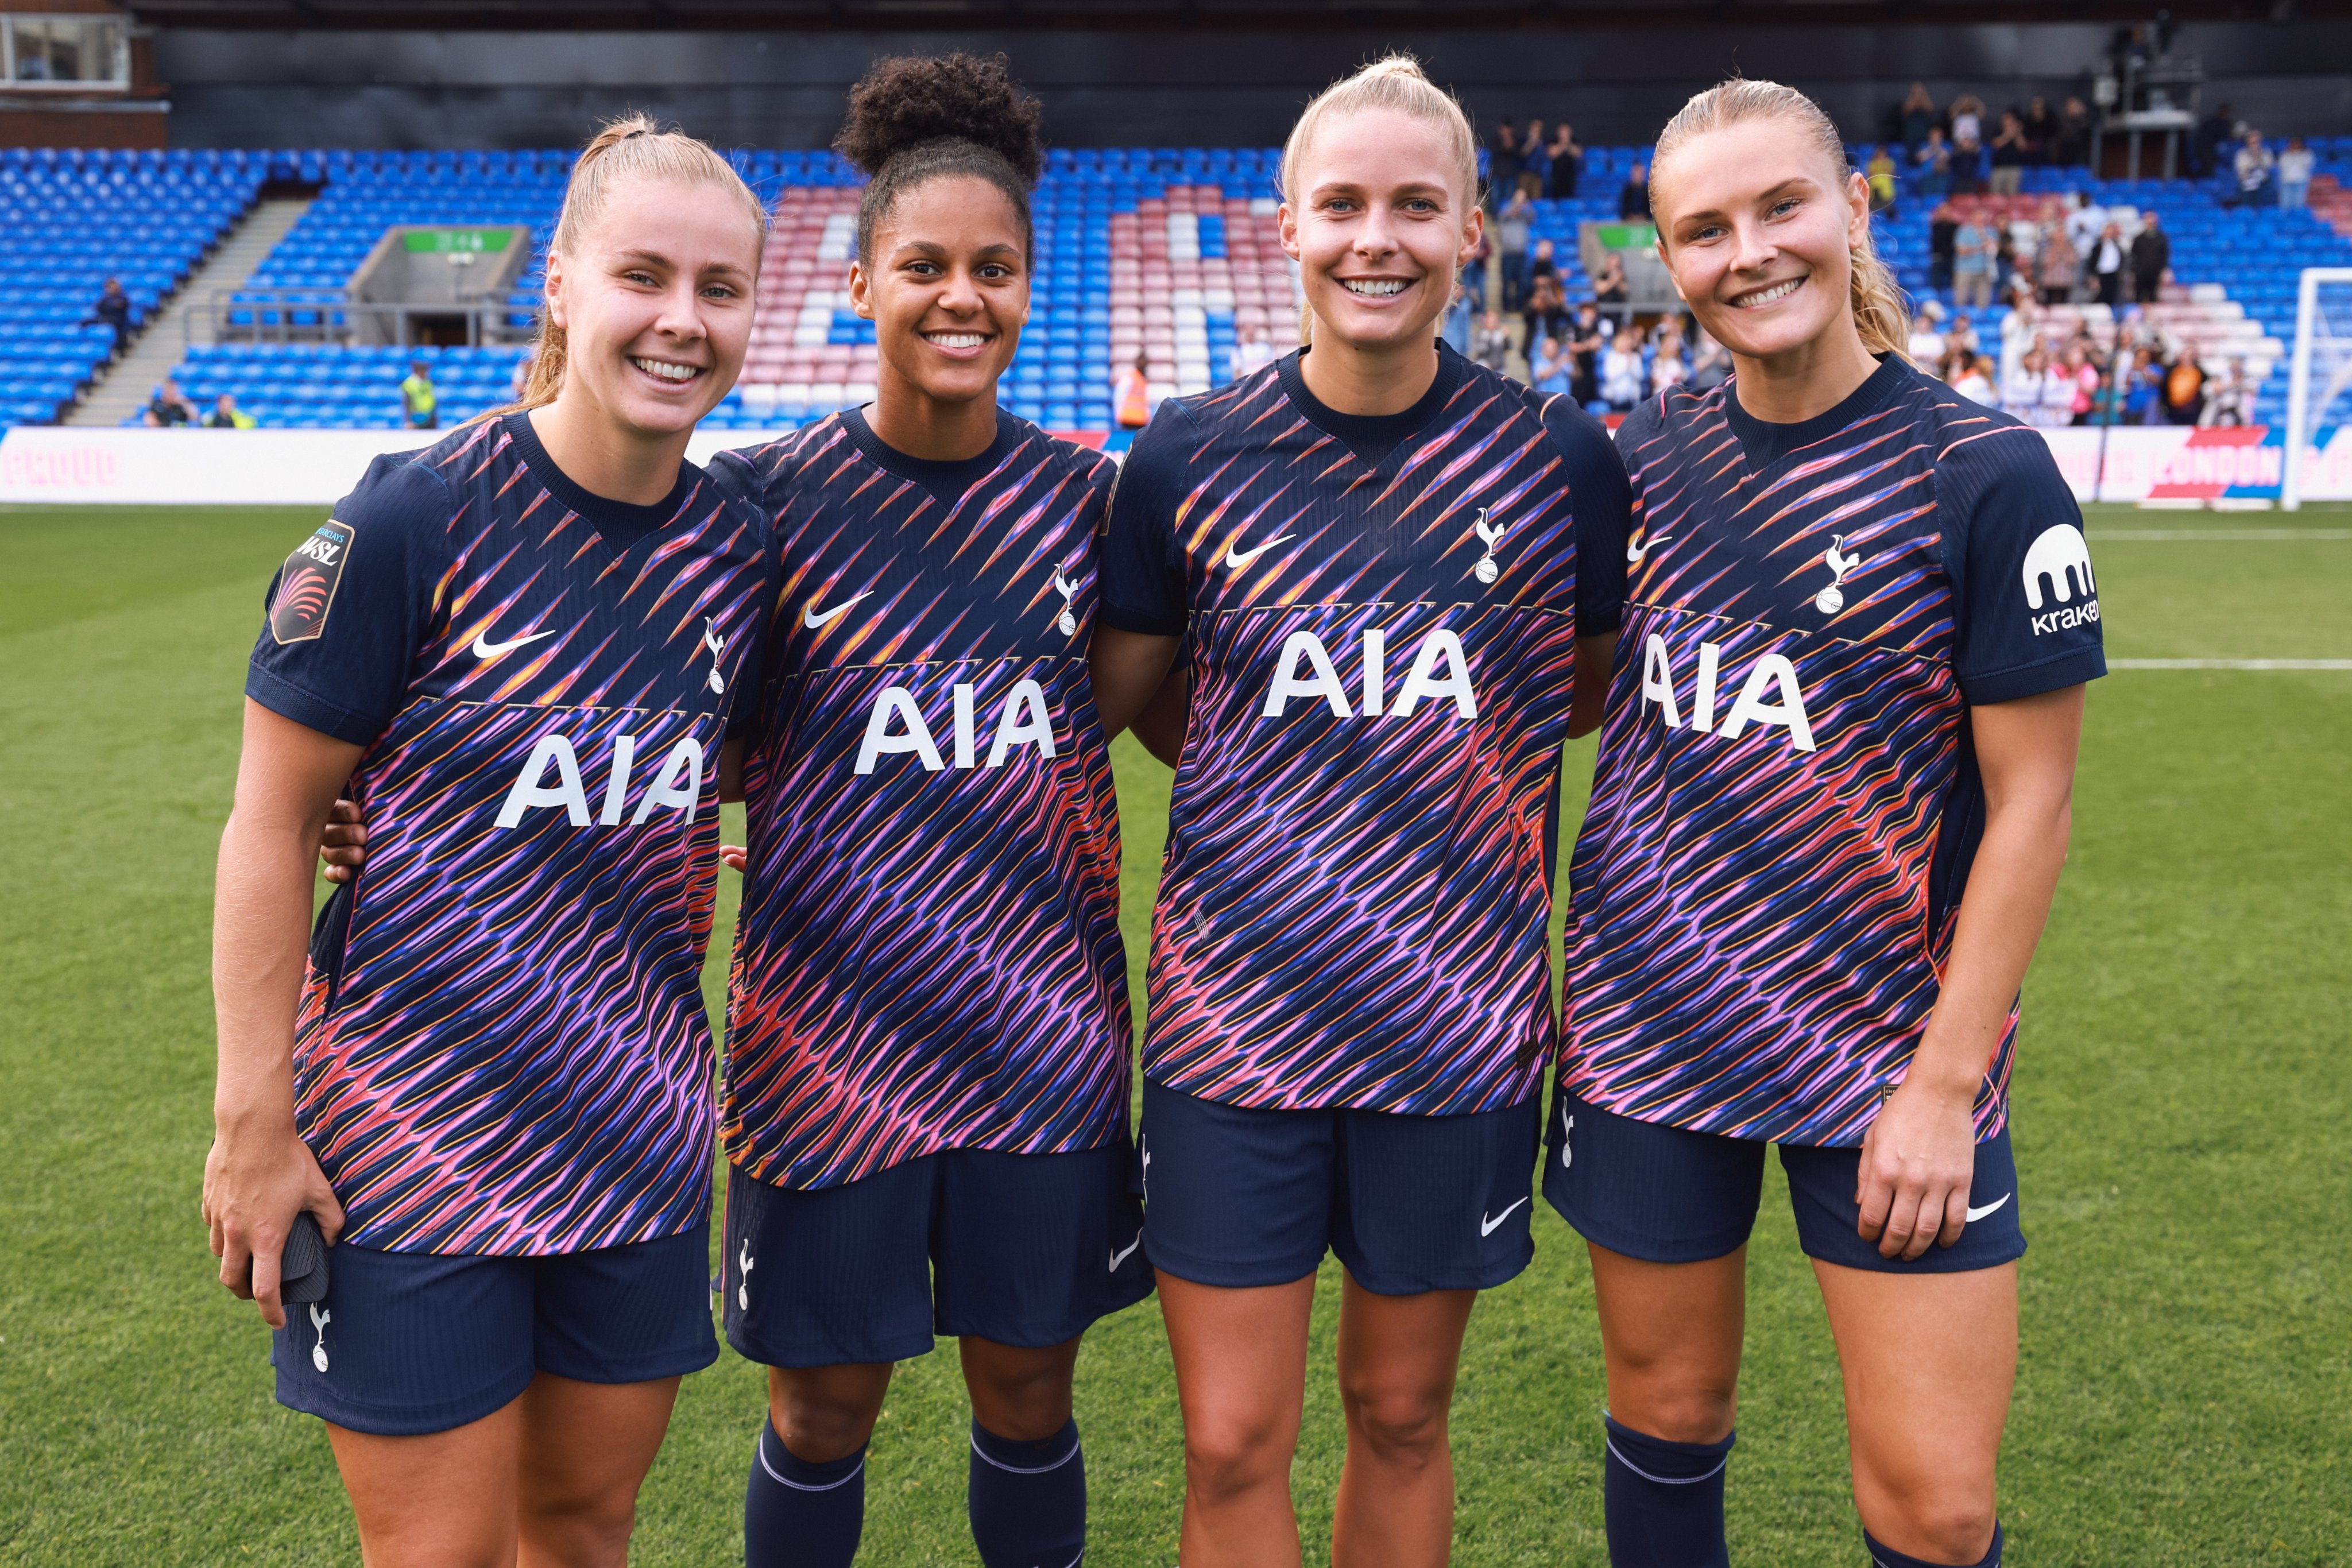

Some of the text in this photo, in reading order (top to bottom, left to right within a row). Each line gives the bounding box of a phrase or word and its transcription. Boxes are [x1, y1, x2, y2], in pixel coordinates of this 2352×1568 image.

[296, 536, 341, 567] WSL
[2031, 599, 2099, 636] kraken
[1262, 629, 1478, 719] AIA
[1642, 633, 1817, 752] AIA
[853, 679, 1057, 774] AIA
[493, 734, 703, 828] AIA
